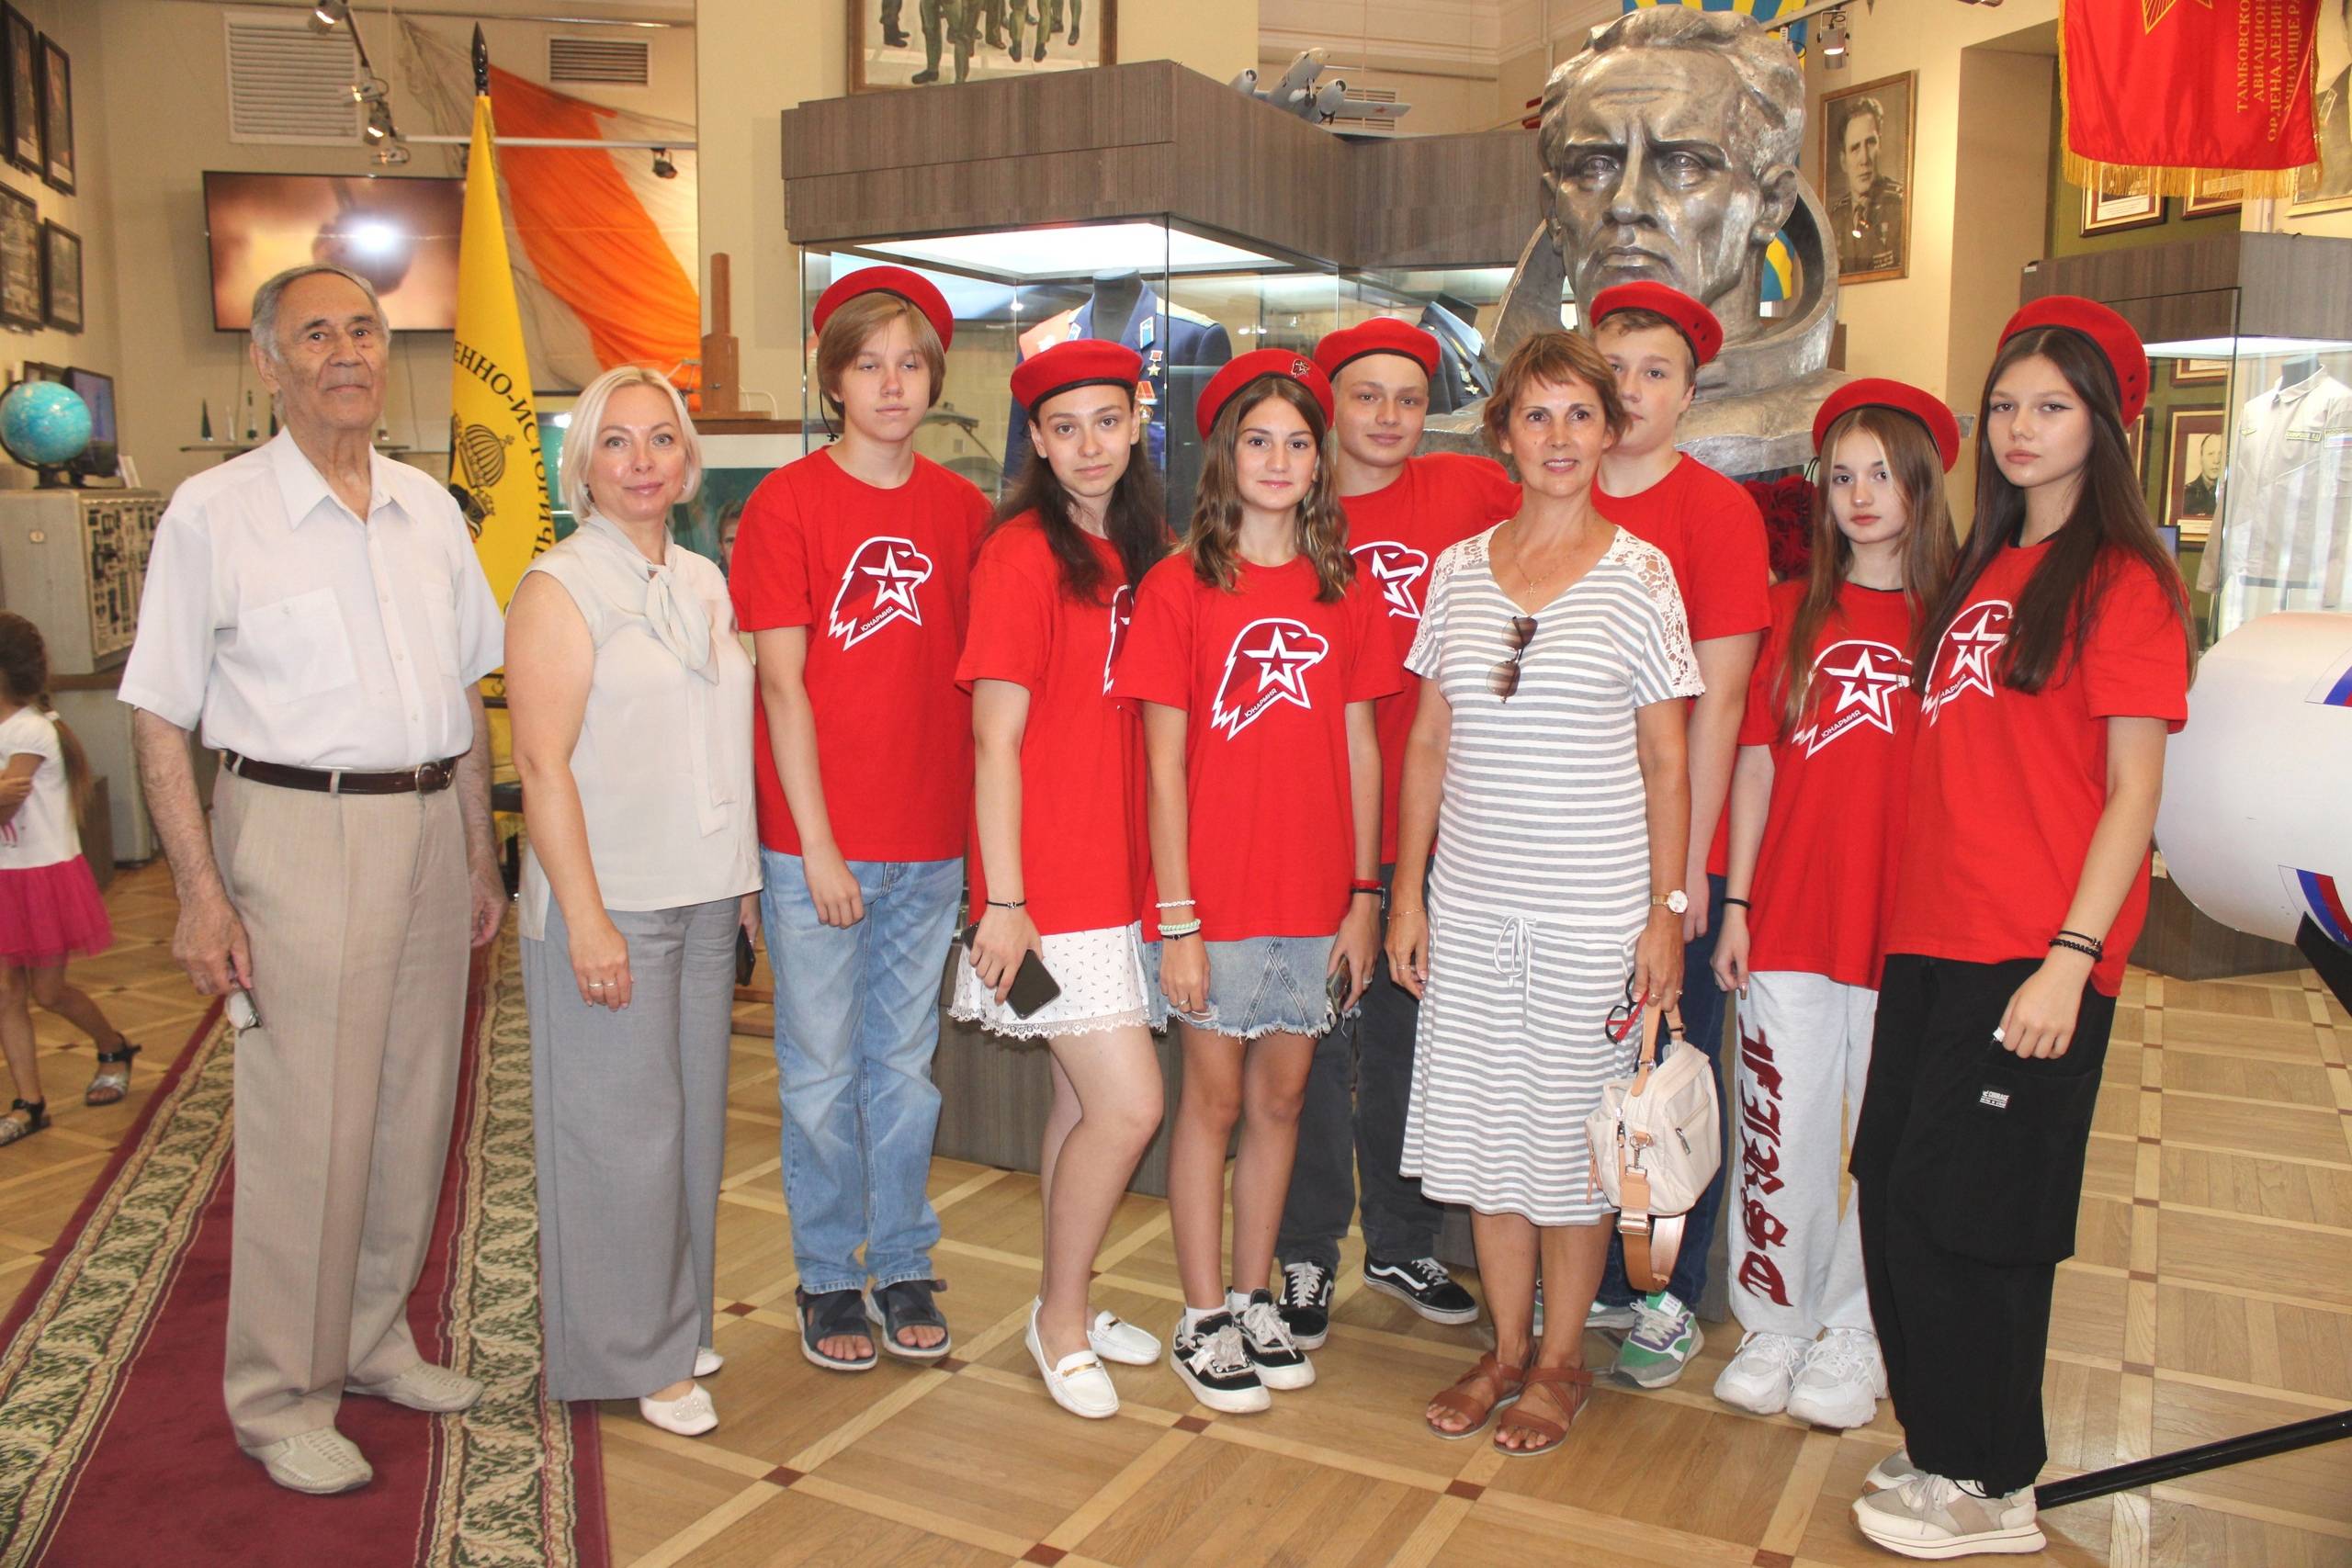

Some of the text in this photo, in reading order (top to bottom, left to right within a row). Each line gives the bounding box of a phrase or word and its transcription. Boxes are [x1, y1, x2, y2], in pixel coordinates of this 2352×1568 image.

[2267, 65, 2283, 141] ОРДЕНА
[860, 605, 894, 632] ЮНАРМИЯ
[1244, 687, 1278, 718] ЮНАРМИЯ
[1820, 709, 1861, 739] ЮНАРМИЯ
